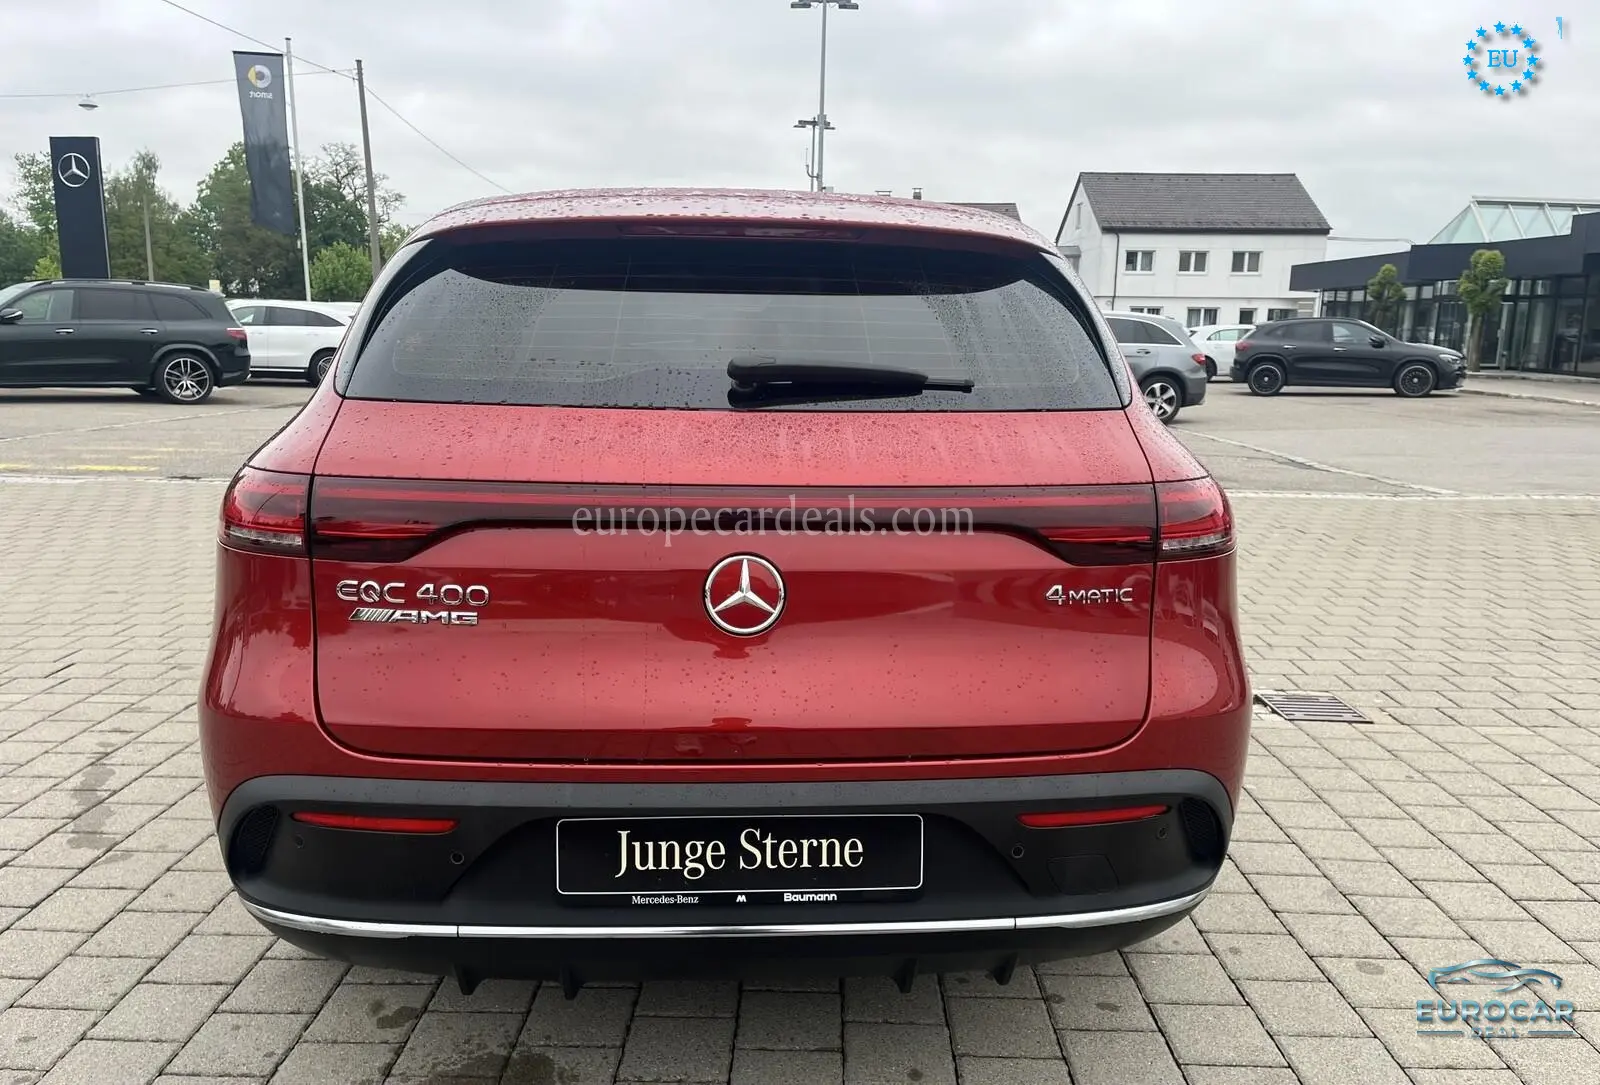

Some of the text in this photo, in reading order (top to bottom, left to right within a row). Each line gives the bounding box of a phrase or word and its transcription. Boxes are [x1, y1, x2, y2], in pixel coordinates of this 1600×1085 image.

[336, 579, 489, 606] EQC 400
[390, 610, 478, 625] AMG
[615, 828, 864, 879] Junge Sterne
[631, 895, 699, 905] Mercedes-Benz
[783, 892, 837, 902] Baumann
